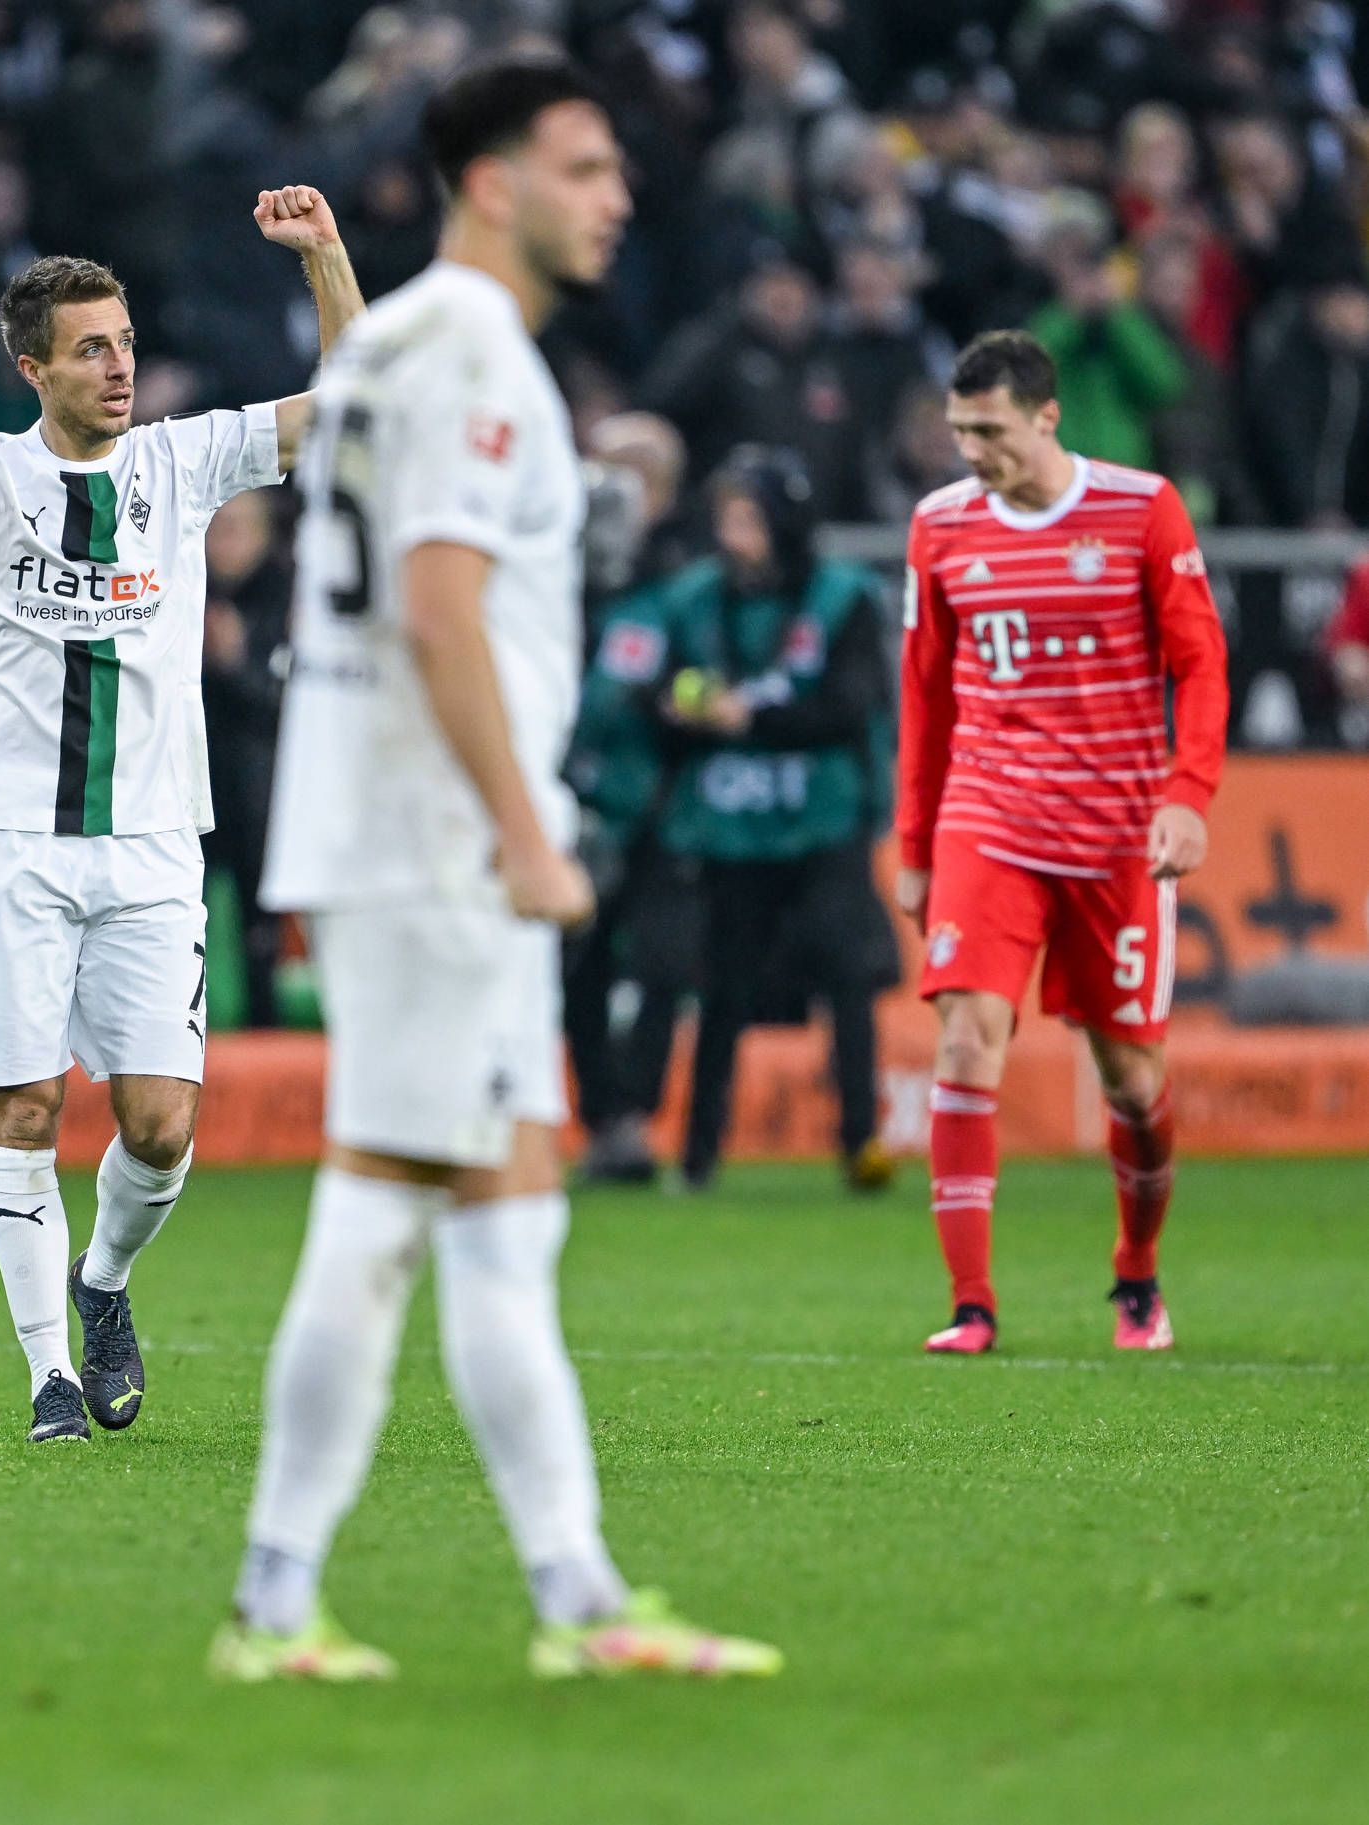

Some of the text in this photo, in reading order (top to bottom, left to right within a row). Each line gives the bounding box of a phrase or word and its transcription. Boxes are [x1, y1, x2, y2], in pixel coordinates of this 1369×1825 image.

[16, 601, 160, 626] Invest in yourself
[189, 941, 206, 1015] 7
[1113, 926, 1147, 989] 5
